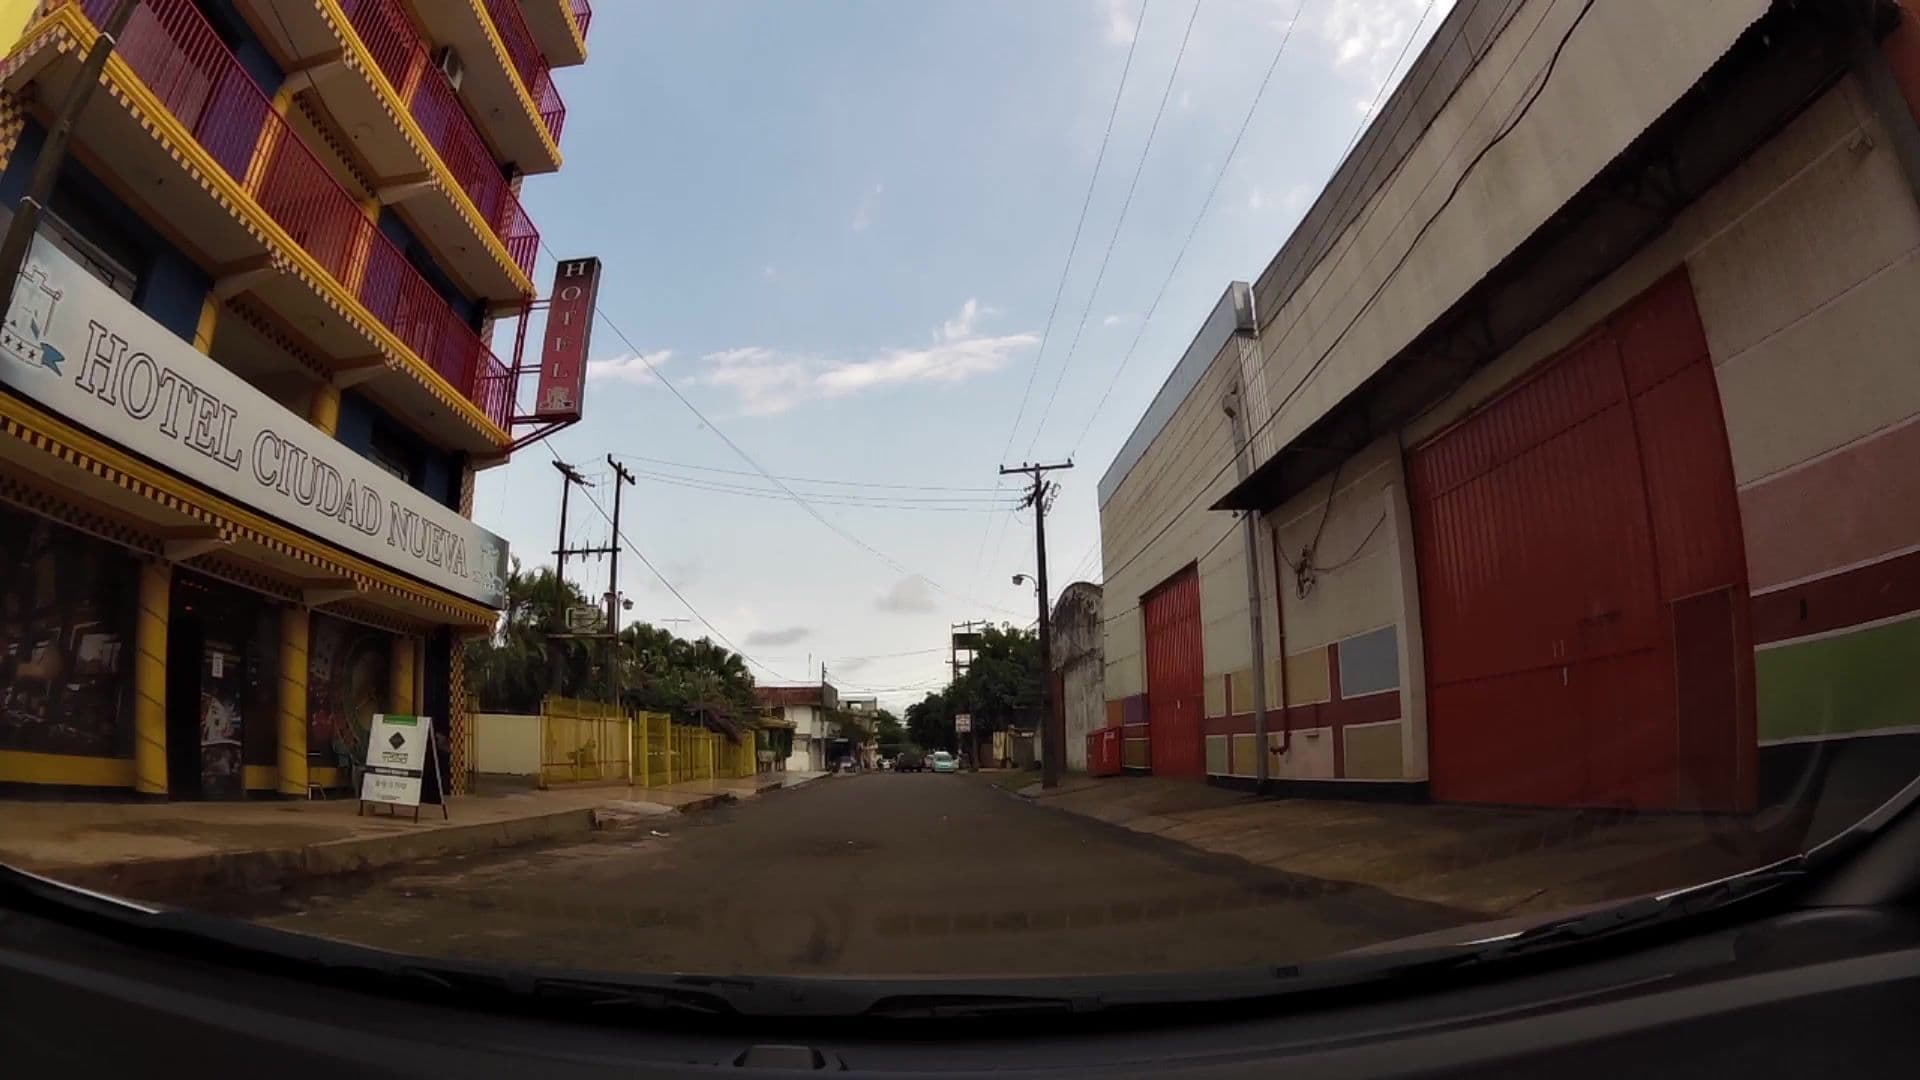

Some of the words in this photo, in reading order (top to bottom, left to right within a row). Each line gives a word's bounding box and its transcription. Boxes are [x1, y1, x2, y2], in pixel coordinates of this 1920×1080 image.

[551, 261, 587, 378] HOTEL
[76, 320, 243, 471] HOTEL
[252, 429, 384, 537] CIUDAD
[386, 500, 469, 578] NUEVA
